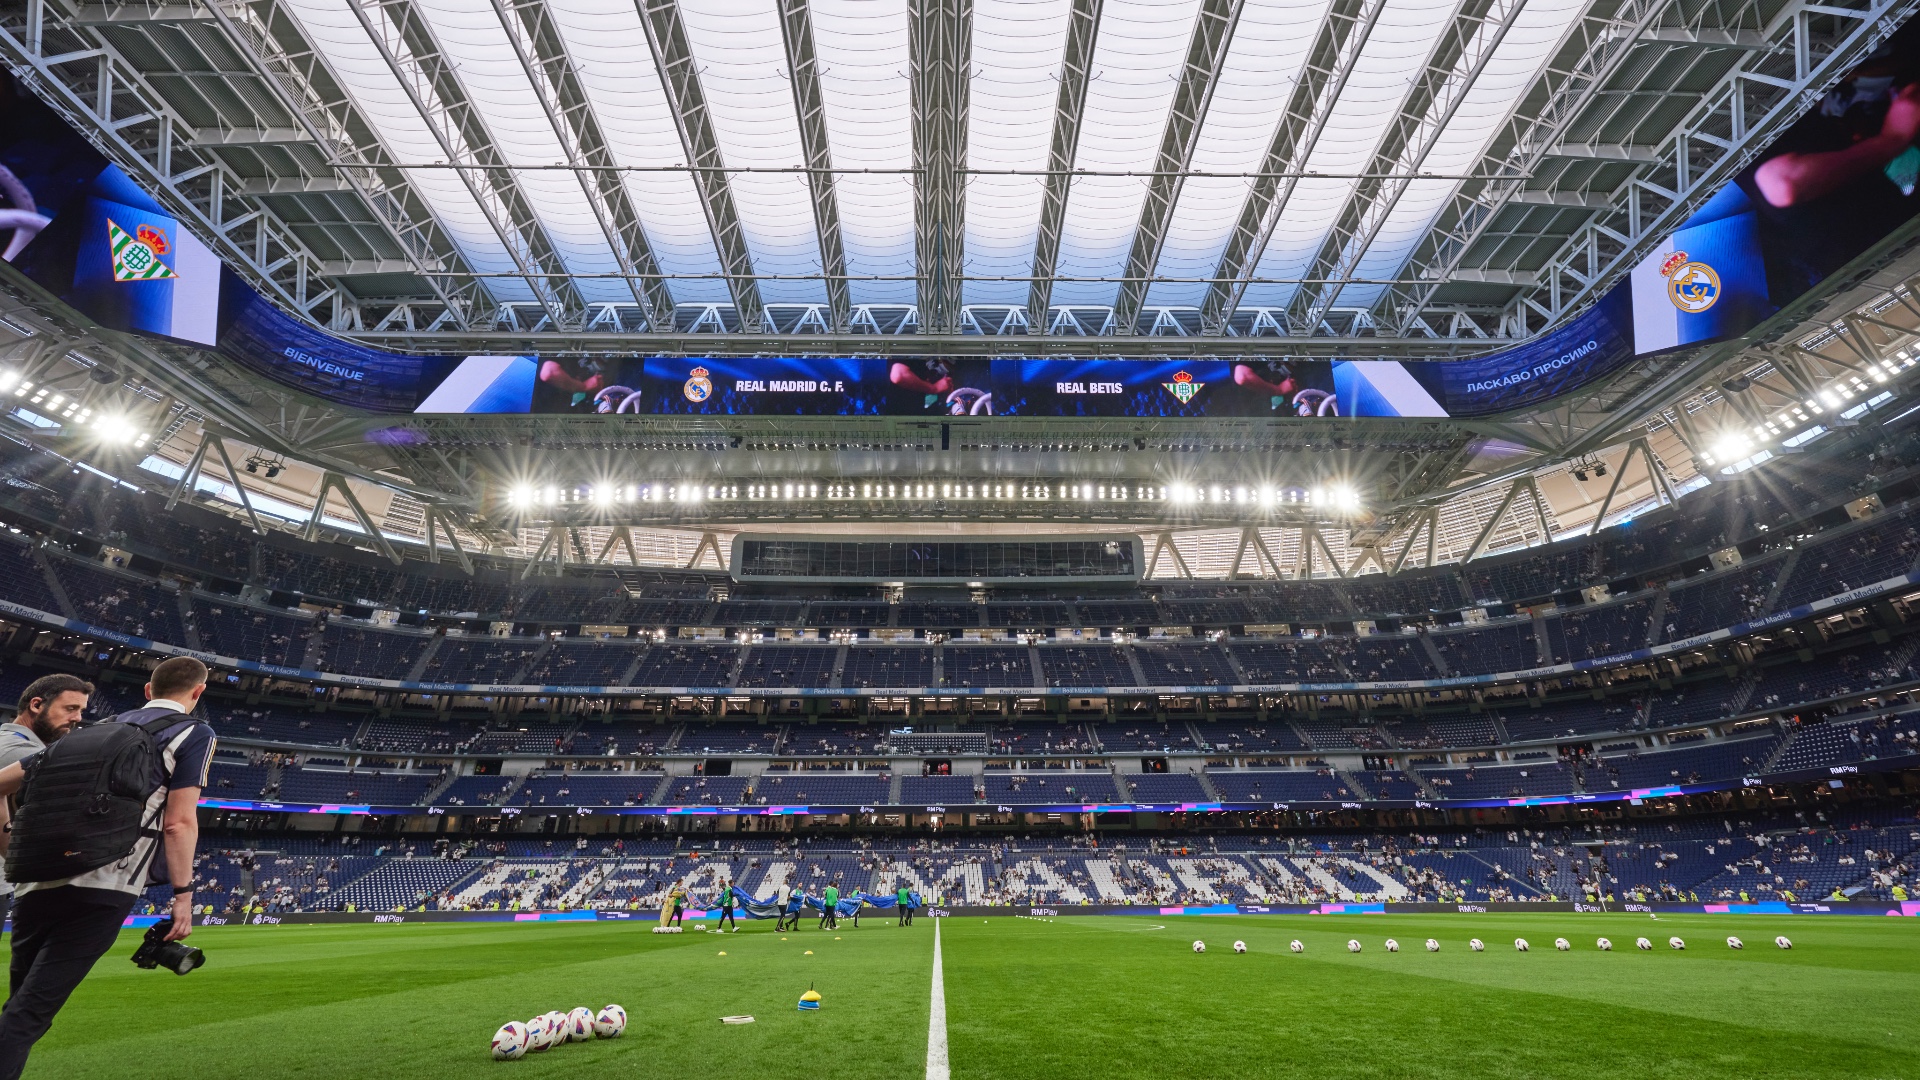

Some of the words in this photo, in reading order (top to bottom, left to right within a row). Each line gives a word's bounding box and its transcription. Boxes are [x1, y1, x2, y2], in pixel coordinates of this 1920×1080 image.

[284, 347, 364, 381] BIENVENUE
[1467, 371, 1531, 392] ЛАСКАВО
[1533, 340, 1597, 377] ПРОСИМО
[735, 380, 766, 392] REAL
[769, 380, 817, 392] MADRID
[819, 380, 832, 392] C.
[834, 380, 844, 392] F.
[1056, 382, 1087, 394] REAL
[1089, 382, 1123, 394] BETIS
[1833, 594, 1852, 606] Real
[1853, 585, 1884, 601] Madrid
[0, 603, 13, 612] eal
[13, 606, 45, 621] Madrid
[1749, 618, 1765, 630] Real
[1766, 611, 1791, 626] Madrid
[87, 626, 103, 638] Real
[103, 629, 130, 643] Madrid
[1671, 641, 1687, 651] Real
[1688, 636, 1712, 649] Madrid
[172, 648, 189, 658] Real
[190, 651, 217, 663] Madrid
[1592, 658, 1608, 666] Real
[1609, 653, 1633, 664] Madrid
[258, 664, 276, 673] Real
[277, 667, 300, 676] Madrid
[1515, 671, 1531, 679] Real
[1532, 667, 1555, 676] Madrid
[340, 676, 356, 684] Real
[357, 678, 381, 687] Madrid
[419, 682, 435, 690] Real
[1455, 676, 1478, 684] Madrid
[935, 909, 950, 918] Play
[1583, 904, 1601, 913] Play
[209, 916, 228, 926] Play
[262, 915, 282, 925] Play
